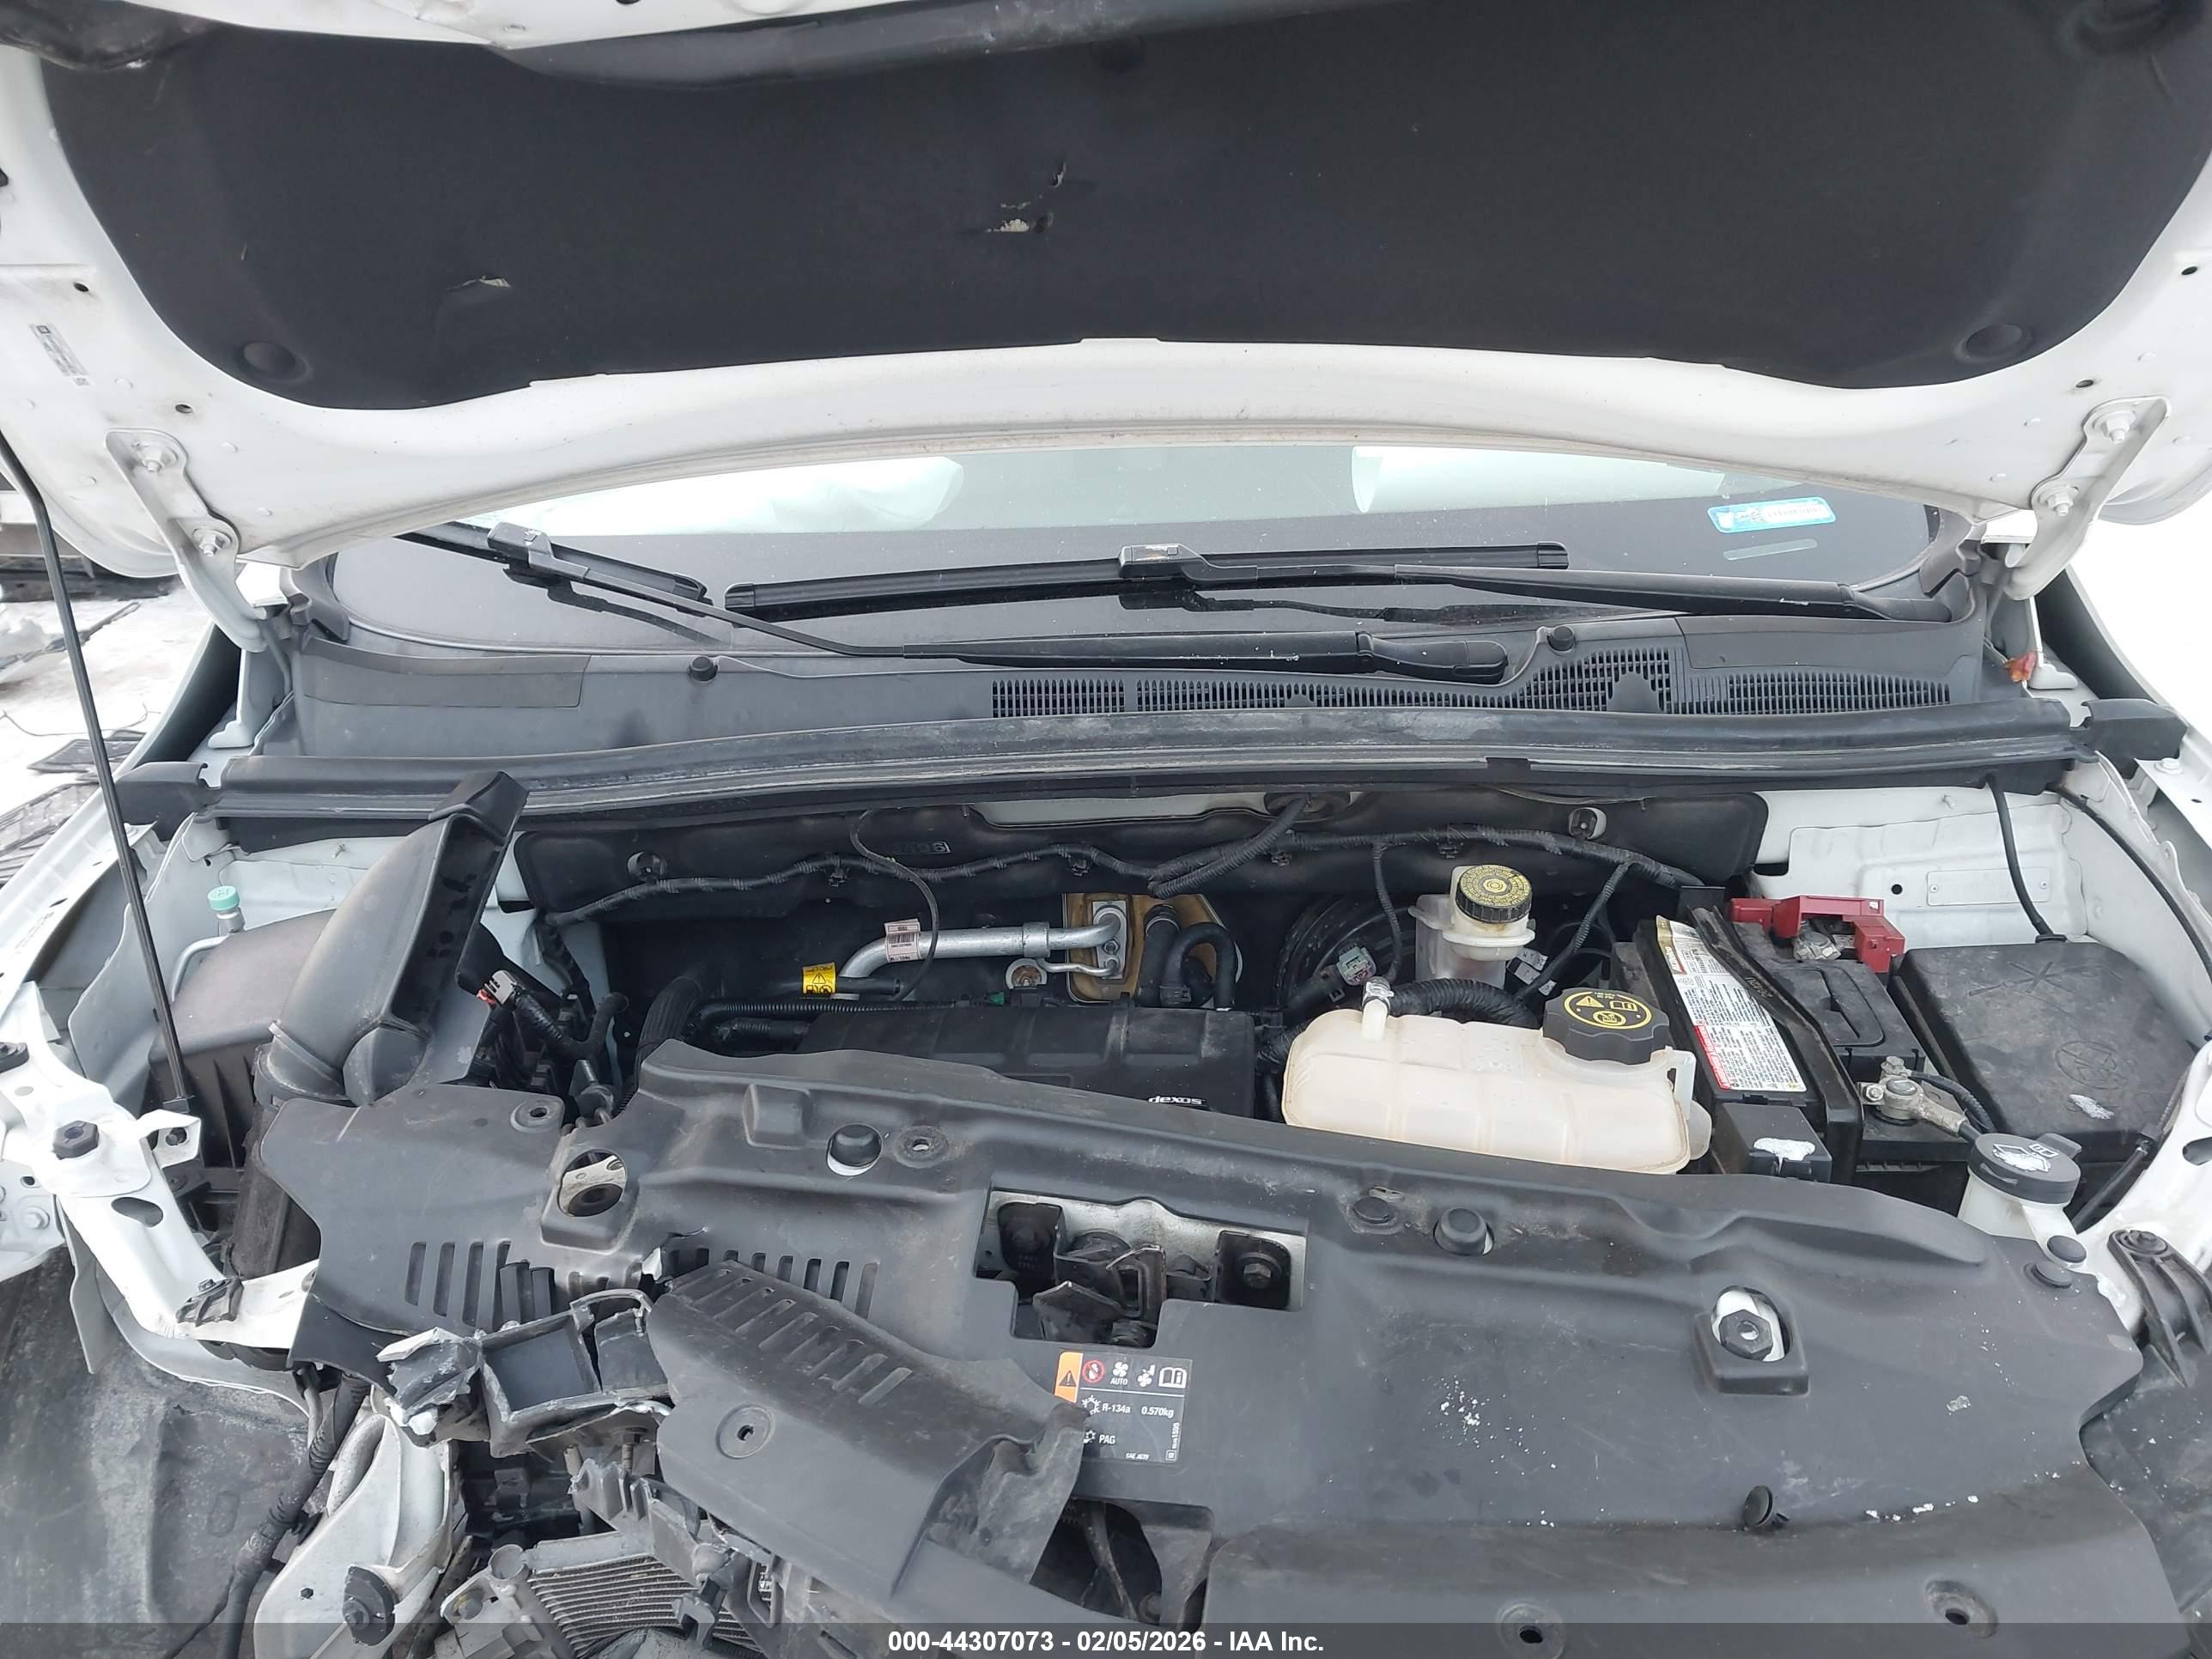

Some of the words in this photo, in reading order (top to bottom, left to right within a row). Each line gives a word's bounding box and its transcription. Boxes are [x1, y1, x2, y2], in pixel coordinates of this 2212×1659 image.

[1148, 1096, 1202, 1105] dexos
[1109, 1377, 1128, 1386] AUTO
[1102, 1402, 1131, 1413] R-134a
[1140, 1406, 1175, 1419] 0.570kg
[1098, 1434, 1116, 1444] PAG
